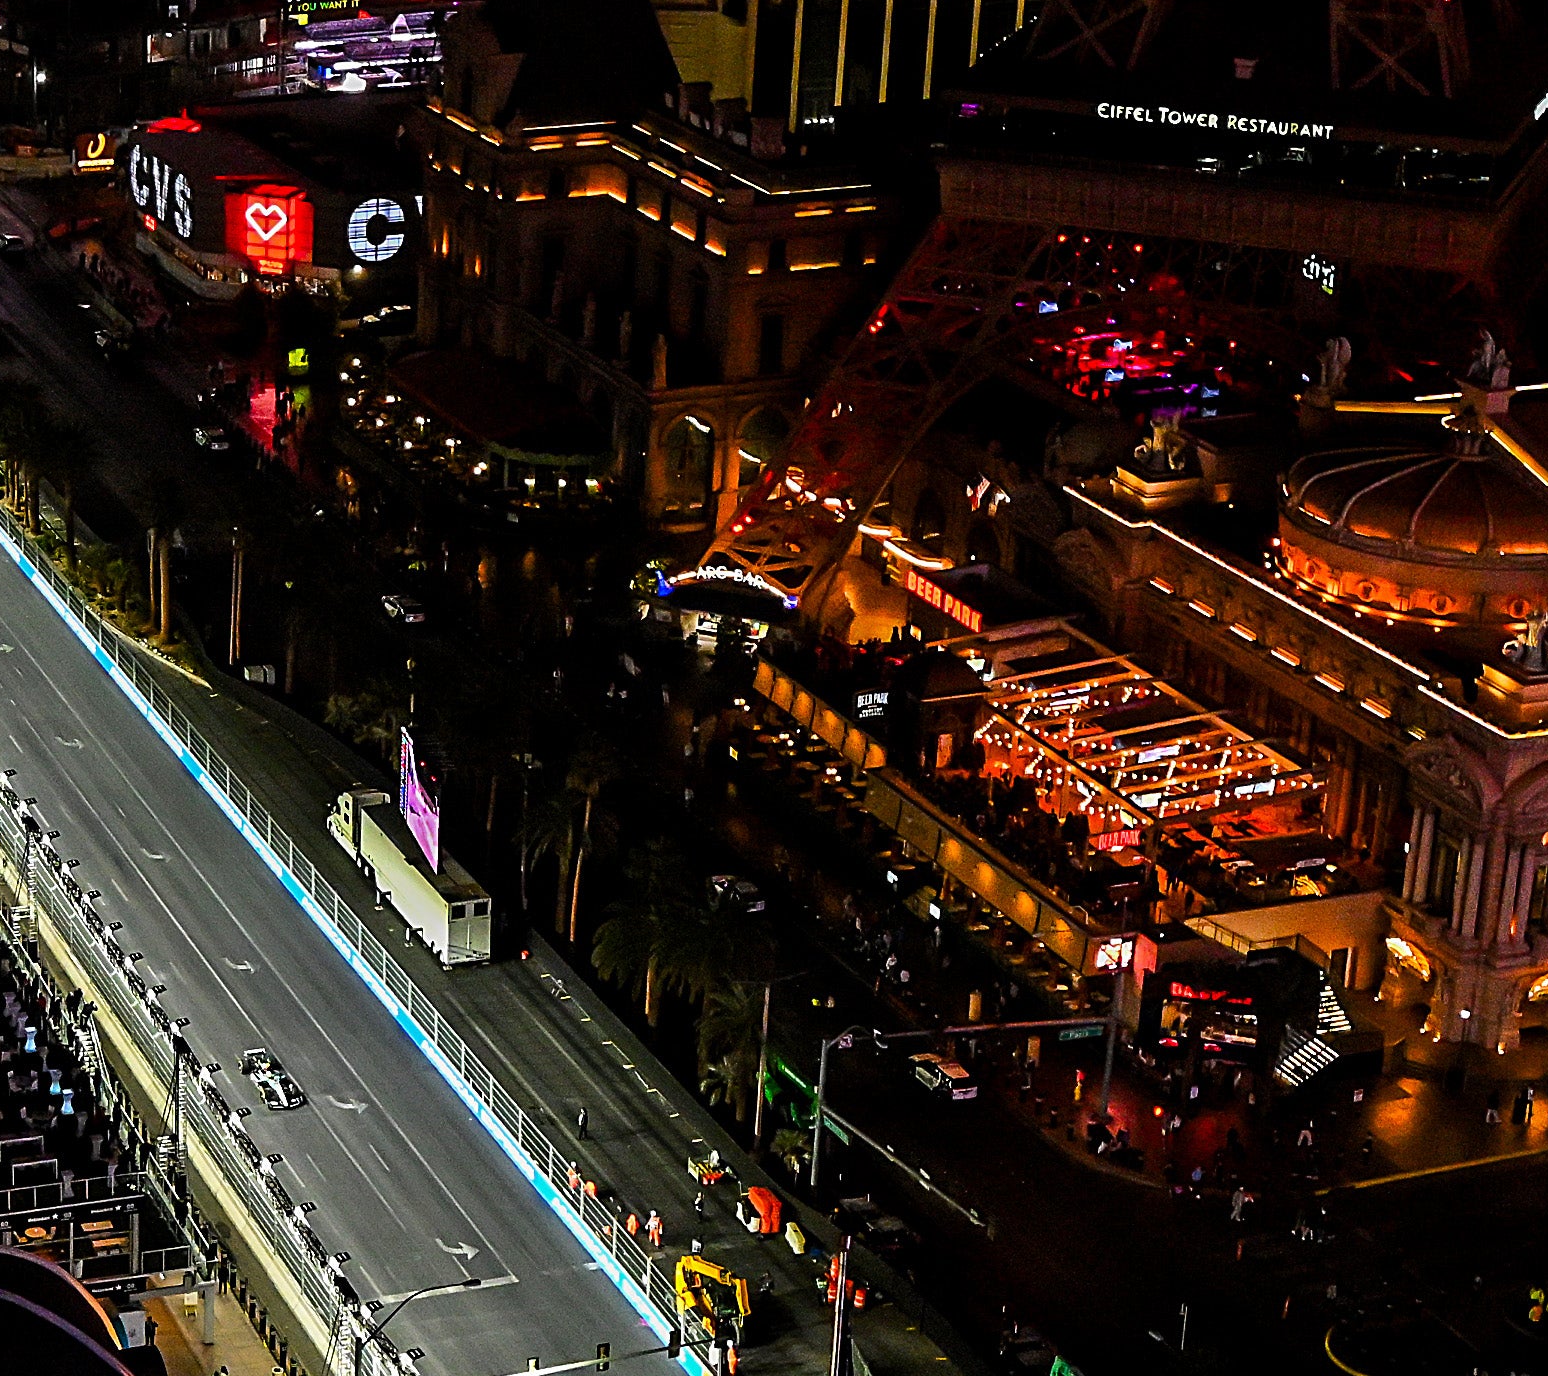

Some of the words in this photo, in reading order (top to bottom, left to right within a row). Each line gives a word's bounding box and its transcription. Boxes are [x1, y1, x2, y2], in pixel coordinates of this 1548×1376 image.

[319, 0, 348, 11] WANT
[1097, 100, 1154, 124] EIFFEL
[1157, 104, 1220, 129] TOWER
[1226, 113, 1334, 141] RESTAURANT
[129, 143, 194, 239] CVS
[732, 567, 767, 590] BAR
[906, 570, 942, 609] BEER
[943, 593, 983, 634] PARK
